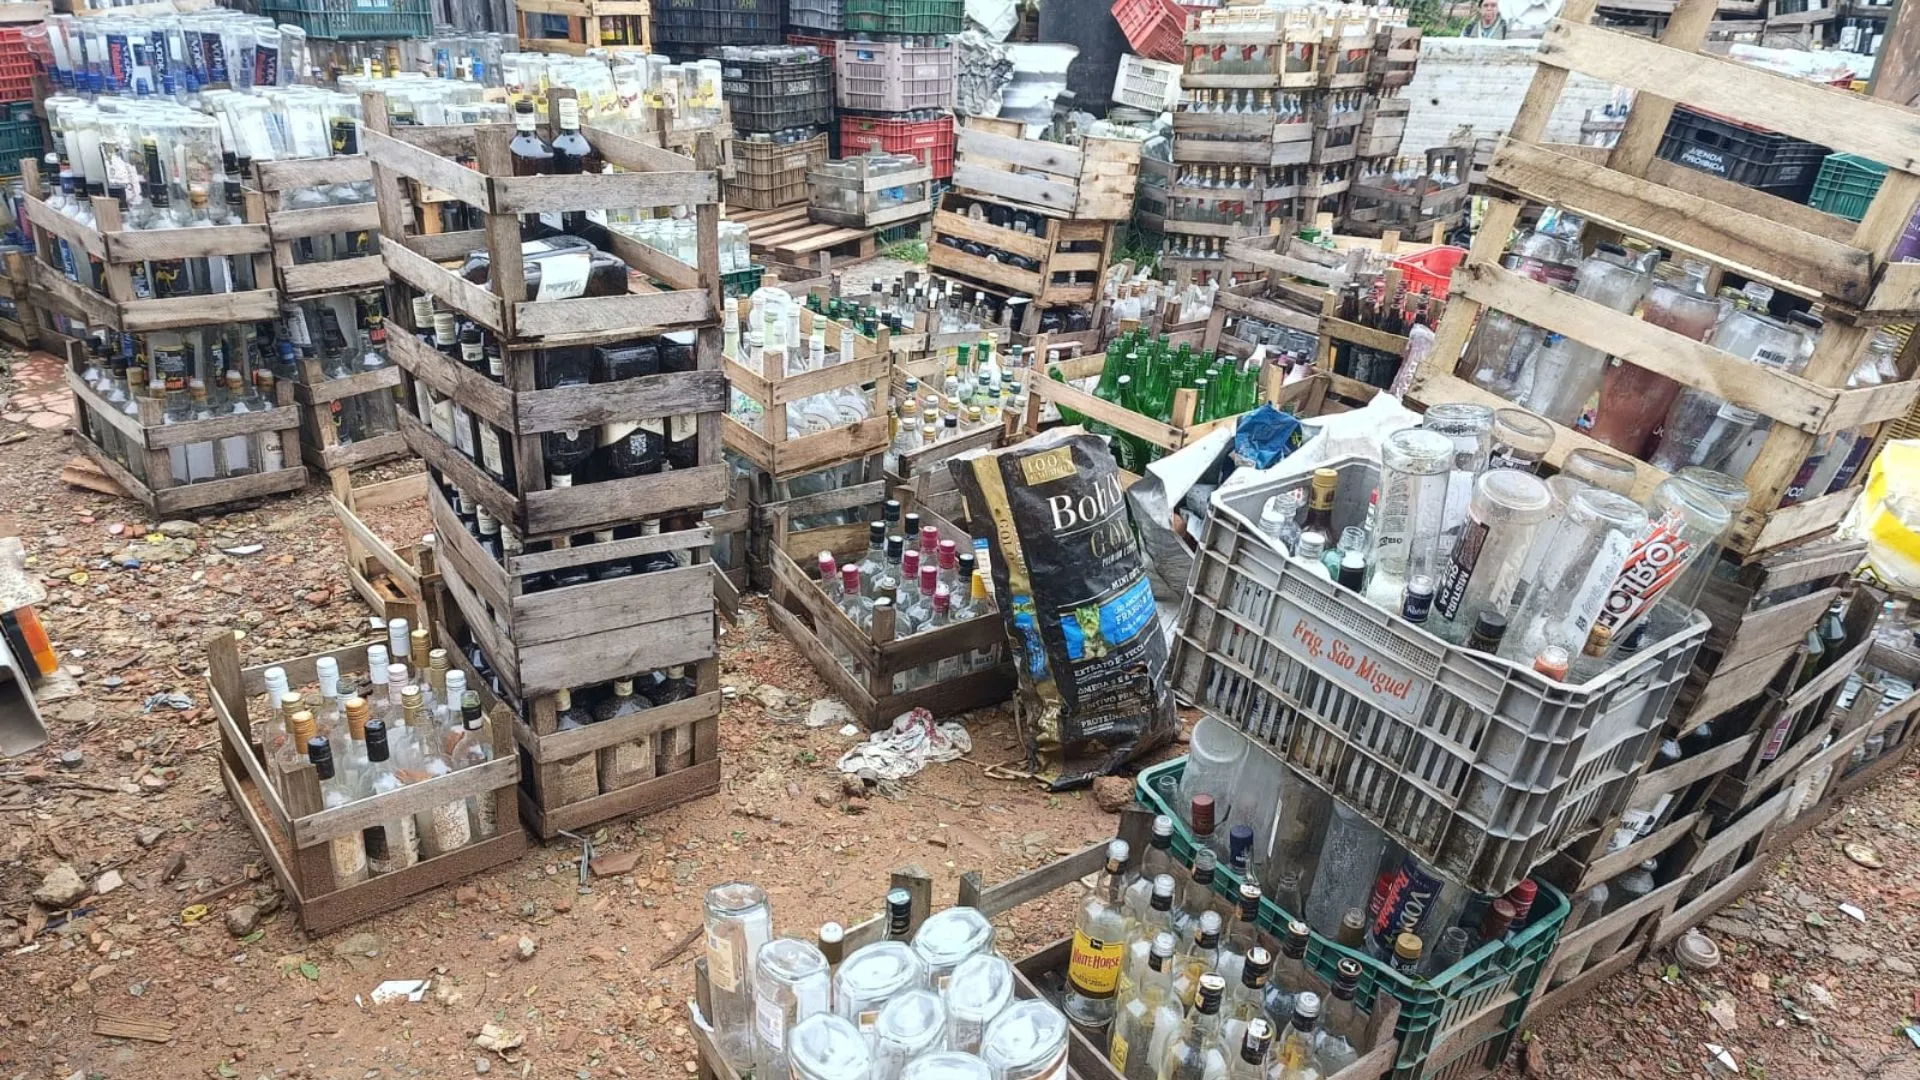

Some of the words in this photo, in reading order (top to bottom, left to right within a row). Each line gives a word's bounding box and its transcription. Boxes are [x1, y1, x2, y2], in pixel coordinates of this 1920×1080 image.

[1681, 153, 1725, 173] PROIBIDA
[1445, 570, 1469, 619] MISTURA
[1074, 660, 1115, 677] EXTRATO
[1292, 619, 1323, 657] Frig.
[1327, 640, 1355, 670] São
[1355, 655, 1413, 700] Miguel
[1401, 891, 1432, 933] VOD
[1072, 947, 1093, 967] WHITE
[1093, 955, 1121, 970] HORSE
